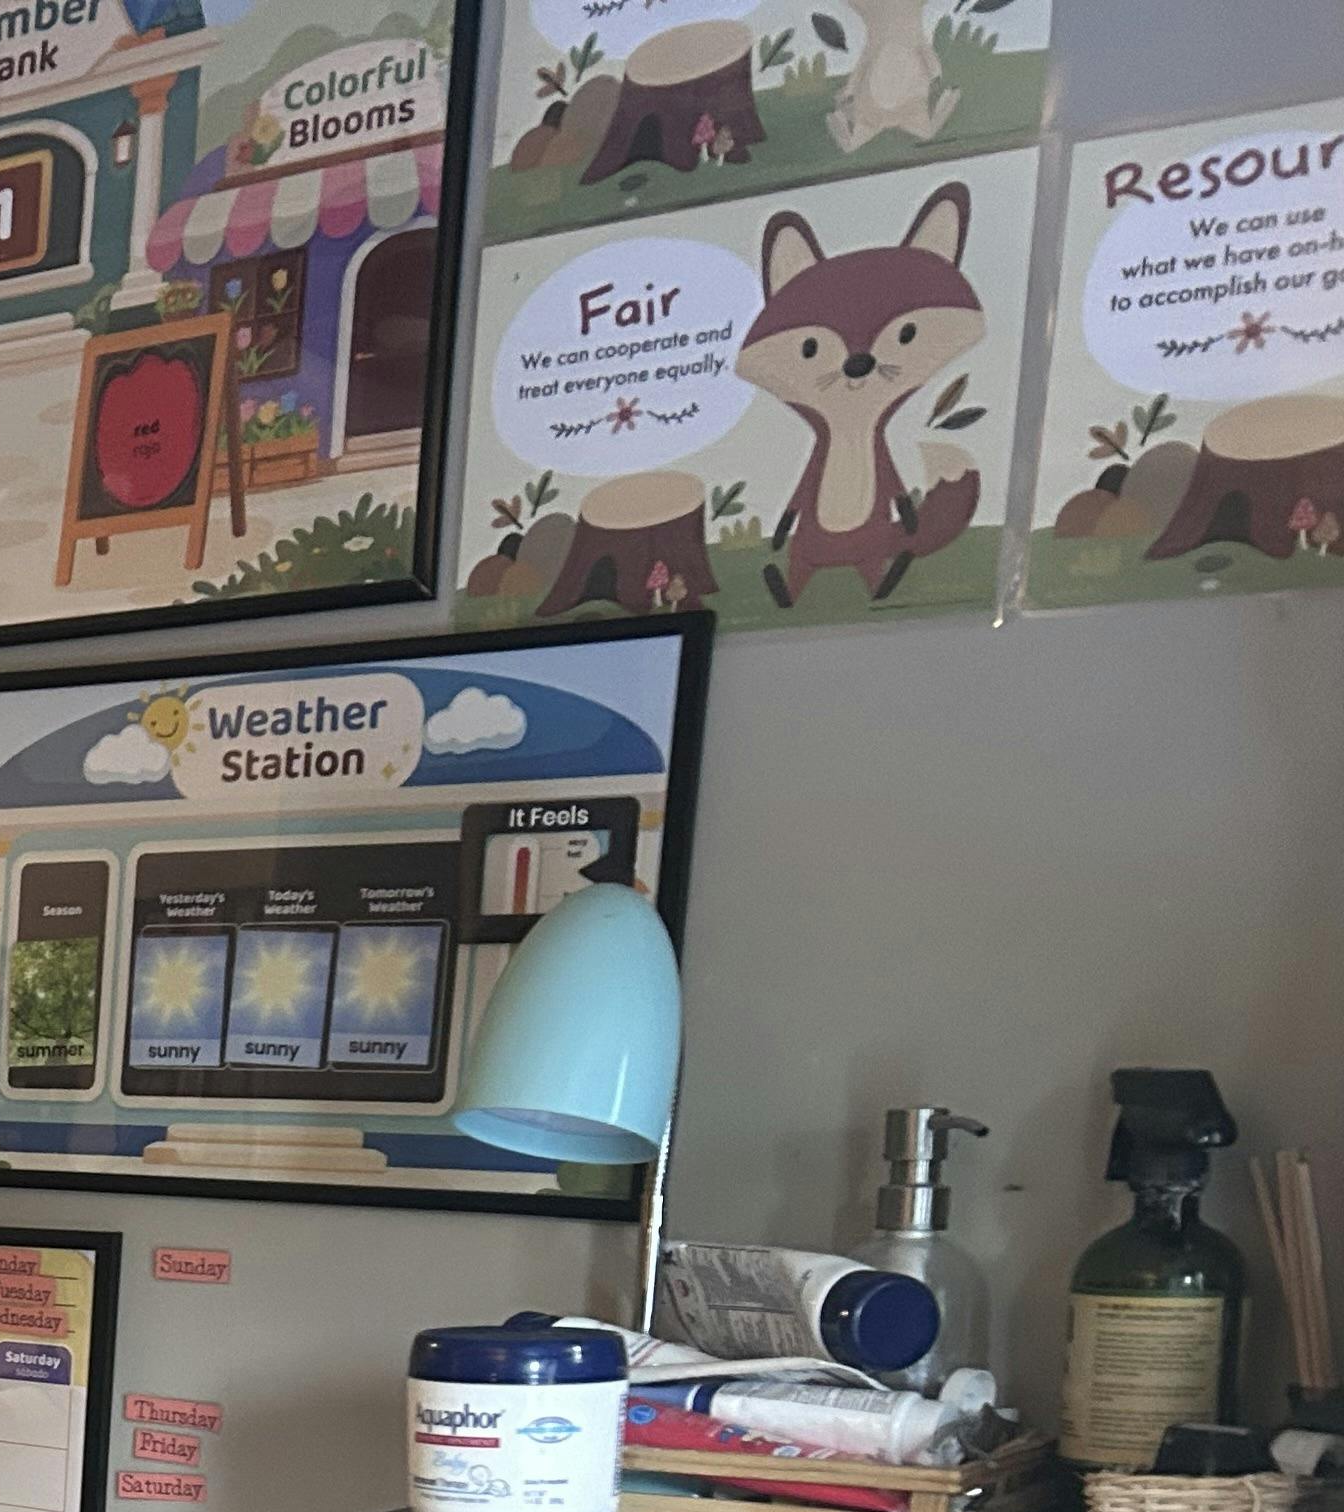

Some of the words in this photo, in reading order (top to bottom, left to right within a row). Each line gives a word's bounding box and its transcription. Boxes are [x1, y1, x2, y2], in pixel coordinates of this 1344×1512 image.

[284, 48, 427, 110] Colorful
[289, 98, 416, 148] Blooms
[1190, 216, 1228, 238] We
[1236, 212, 1278, 234] can
[1286, 207, 1326, 227] use
[1121, 256, 1177, 280] what
[1184, 254, 1216, 270] we
[1224, 244, 1281, 266] have
[1110, 294, 1132, 312] to
[1138, 271, 1267, 306] accomplish
[1274, 271, 1315, 291] our
[579, 282, 681, 336] Fair
[520, 353, 552, 371] We
[557, 349, 589, 367] can
[595, 333, 689, 360] cooperate
[695, 320, 734, 344] and
[518, 379, 558, 400] treat
[564, 369, 649, 394] everyone
[655, 352, 729, 383] equally.
[134, 418, 160, 437] red
[208, 696, 388, 740] Weather
[221, 741, 365, 783] Station
[508, 808, 525, 828] It
[529, 804, 589, 828] Feels
[159, 891, 226, 905] Yesterday's
[268, 888, 315, 903] Today's
[360, 886, 435, 899] Tomorrow's
[42, 904, 83, 918] Season
[166, 905, 215, 918] Weather
[264, 903, 318, 916] Weather
[16, 1042, 86, 1060] summer
[148, 1044, 201, 1063] sunny
[244, 1041, 299, 1061] sunny
[348, 1039, 408, 1060] sunny
[160, 1254, 229, 1280] Sunday
[5, 1350, 62, 1369] Saturday
[134, 1400, 219, 1430] Thursday
[139, 1431, 198, 1462] Friday
[121, 1474, 205, 1500] Saturday
